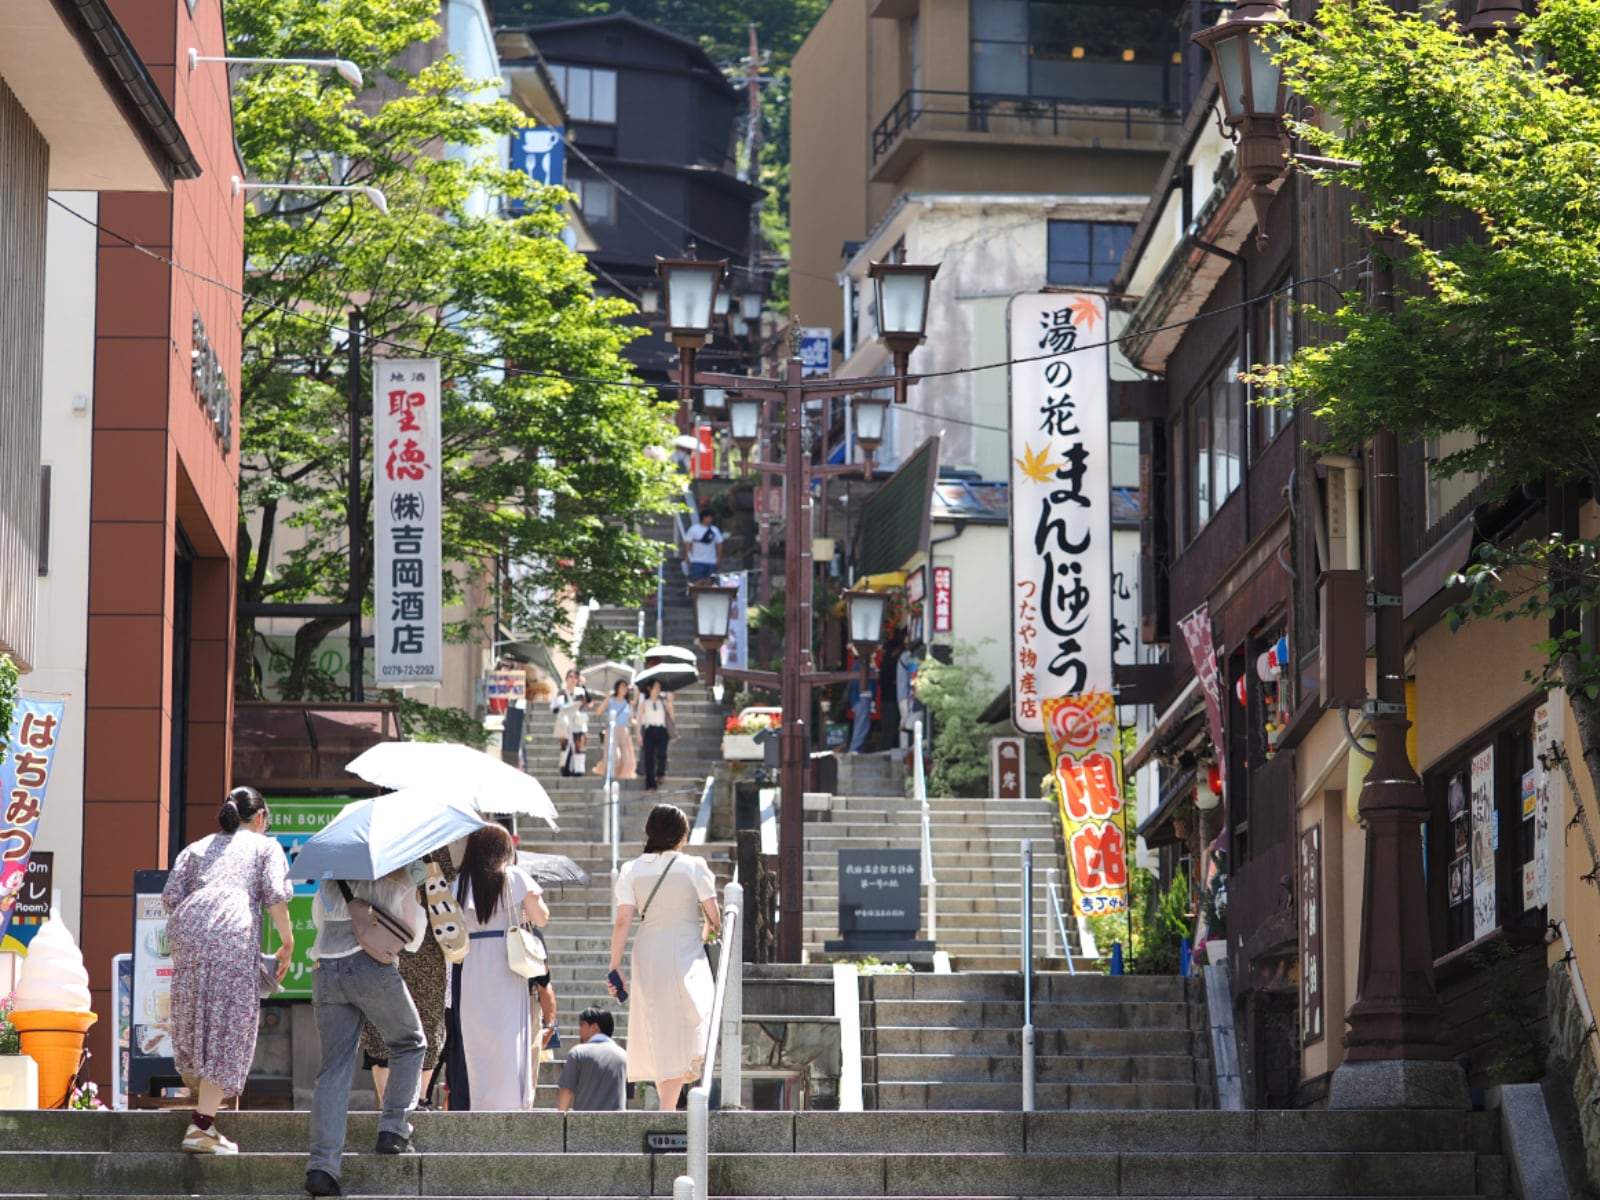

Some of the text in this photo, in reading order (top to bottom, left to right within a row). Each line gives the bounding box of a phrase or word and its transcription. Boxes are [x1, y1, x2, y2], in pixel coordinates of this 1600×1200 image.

[386, 389, 433, 481] 聖徳
[389, 371, 426, 383] 地酒
[1017, 579, 1038, 720] つたや物産店
[0, 712, 57, 860] はちみつ
